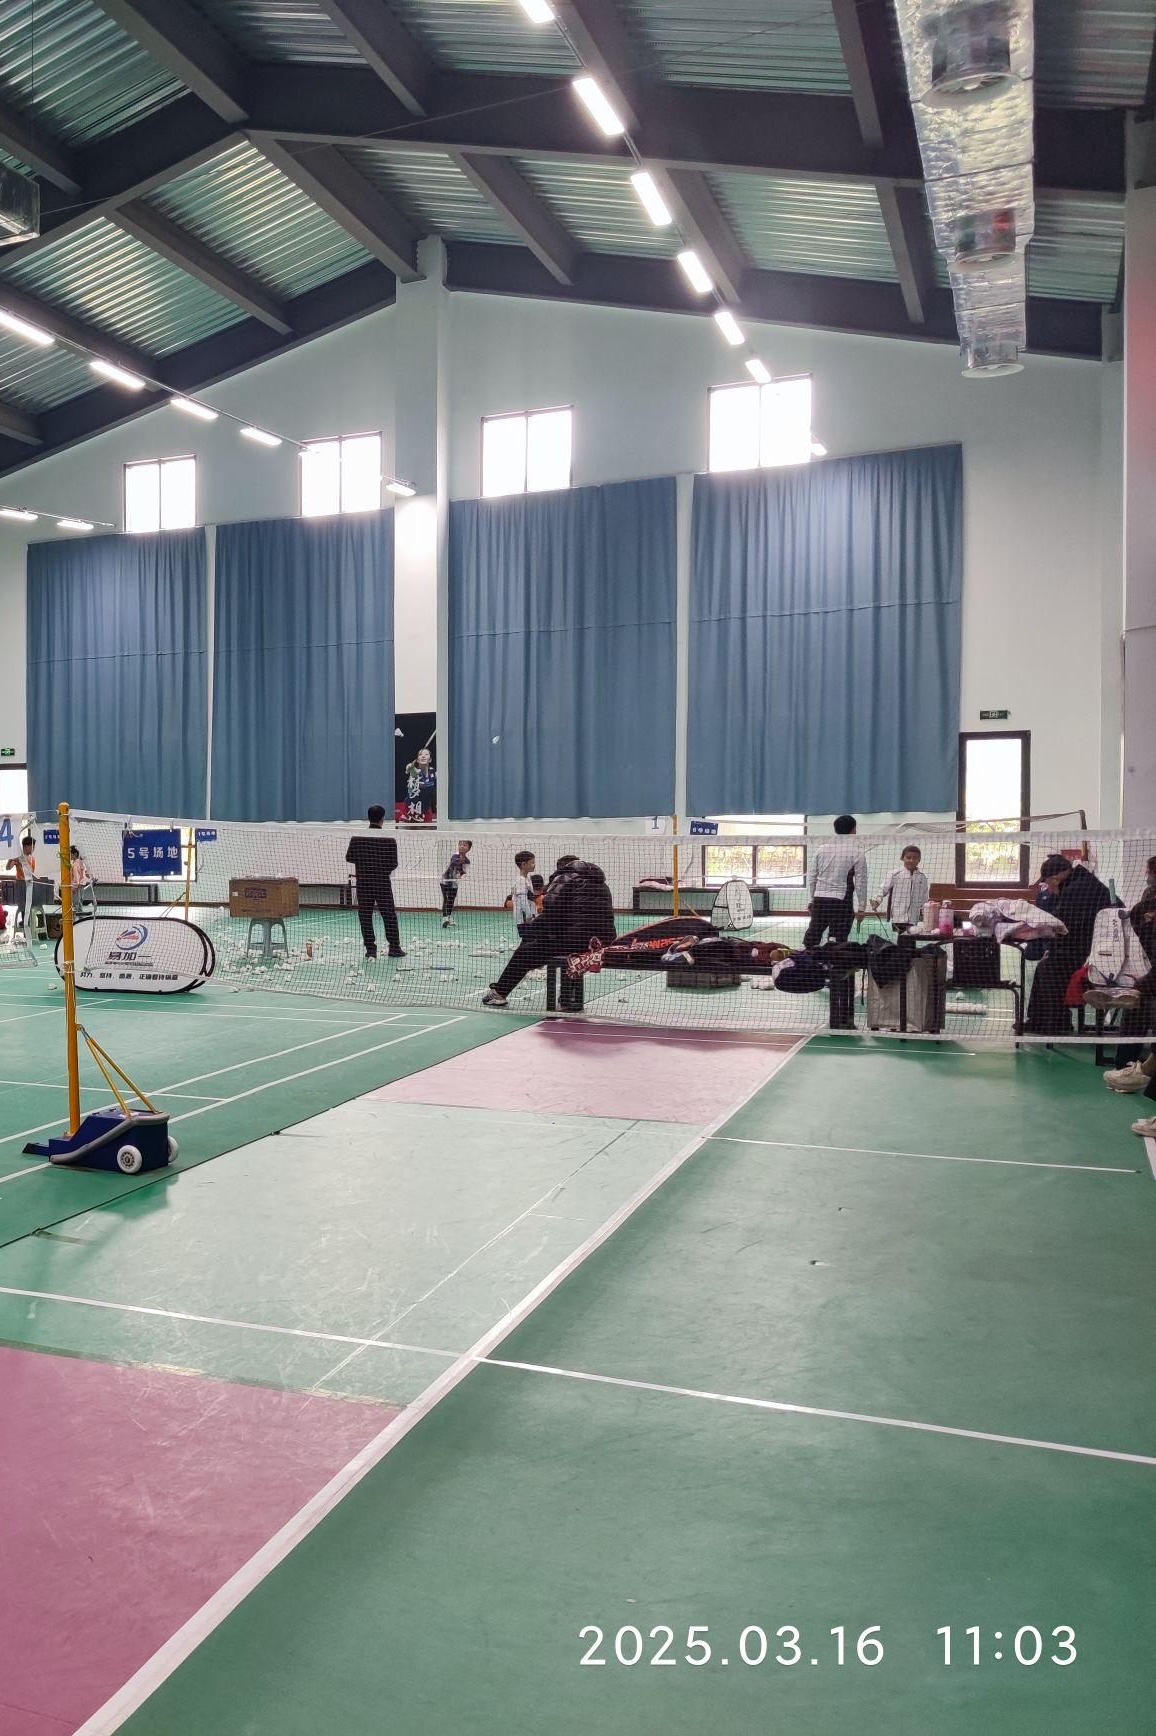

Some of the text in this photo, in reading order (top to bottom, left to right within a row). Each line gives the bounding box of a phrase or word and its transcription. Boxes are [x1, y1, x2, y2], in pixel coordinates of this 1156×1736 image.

[406, 775, 426, 822] 梦想
[127, 846, 179, 860] 5号场地
